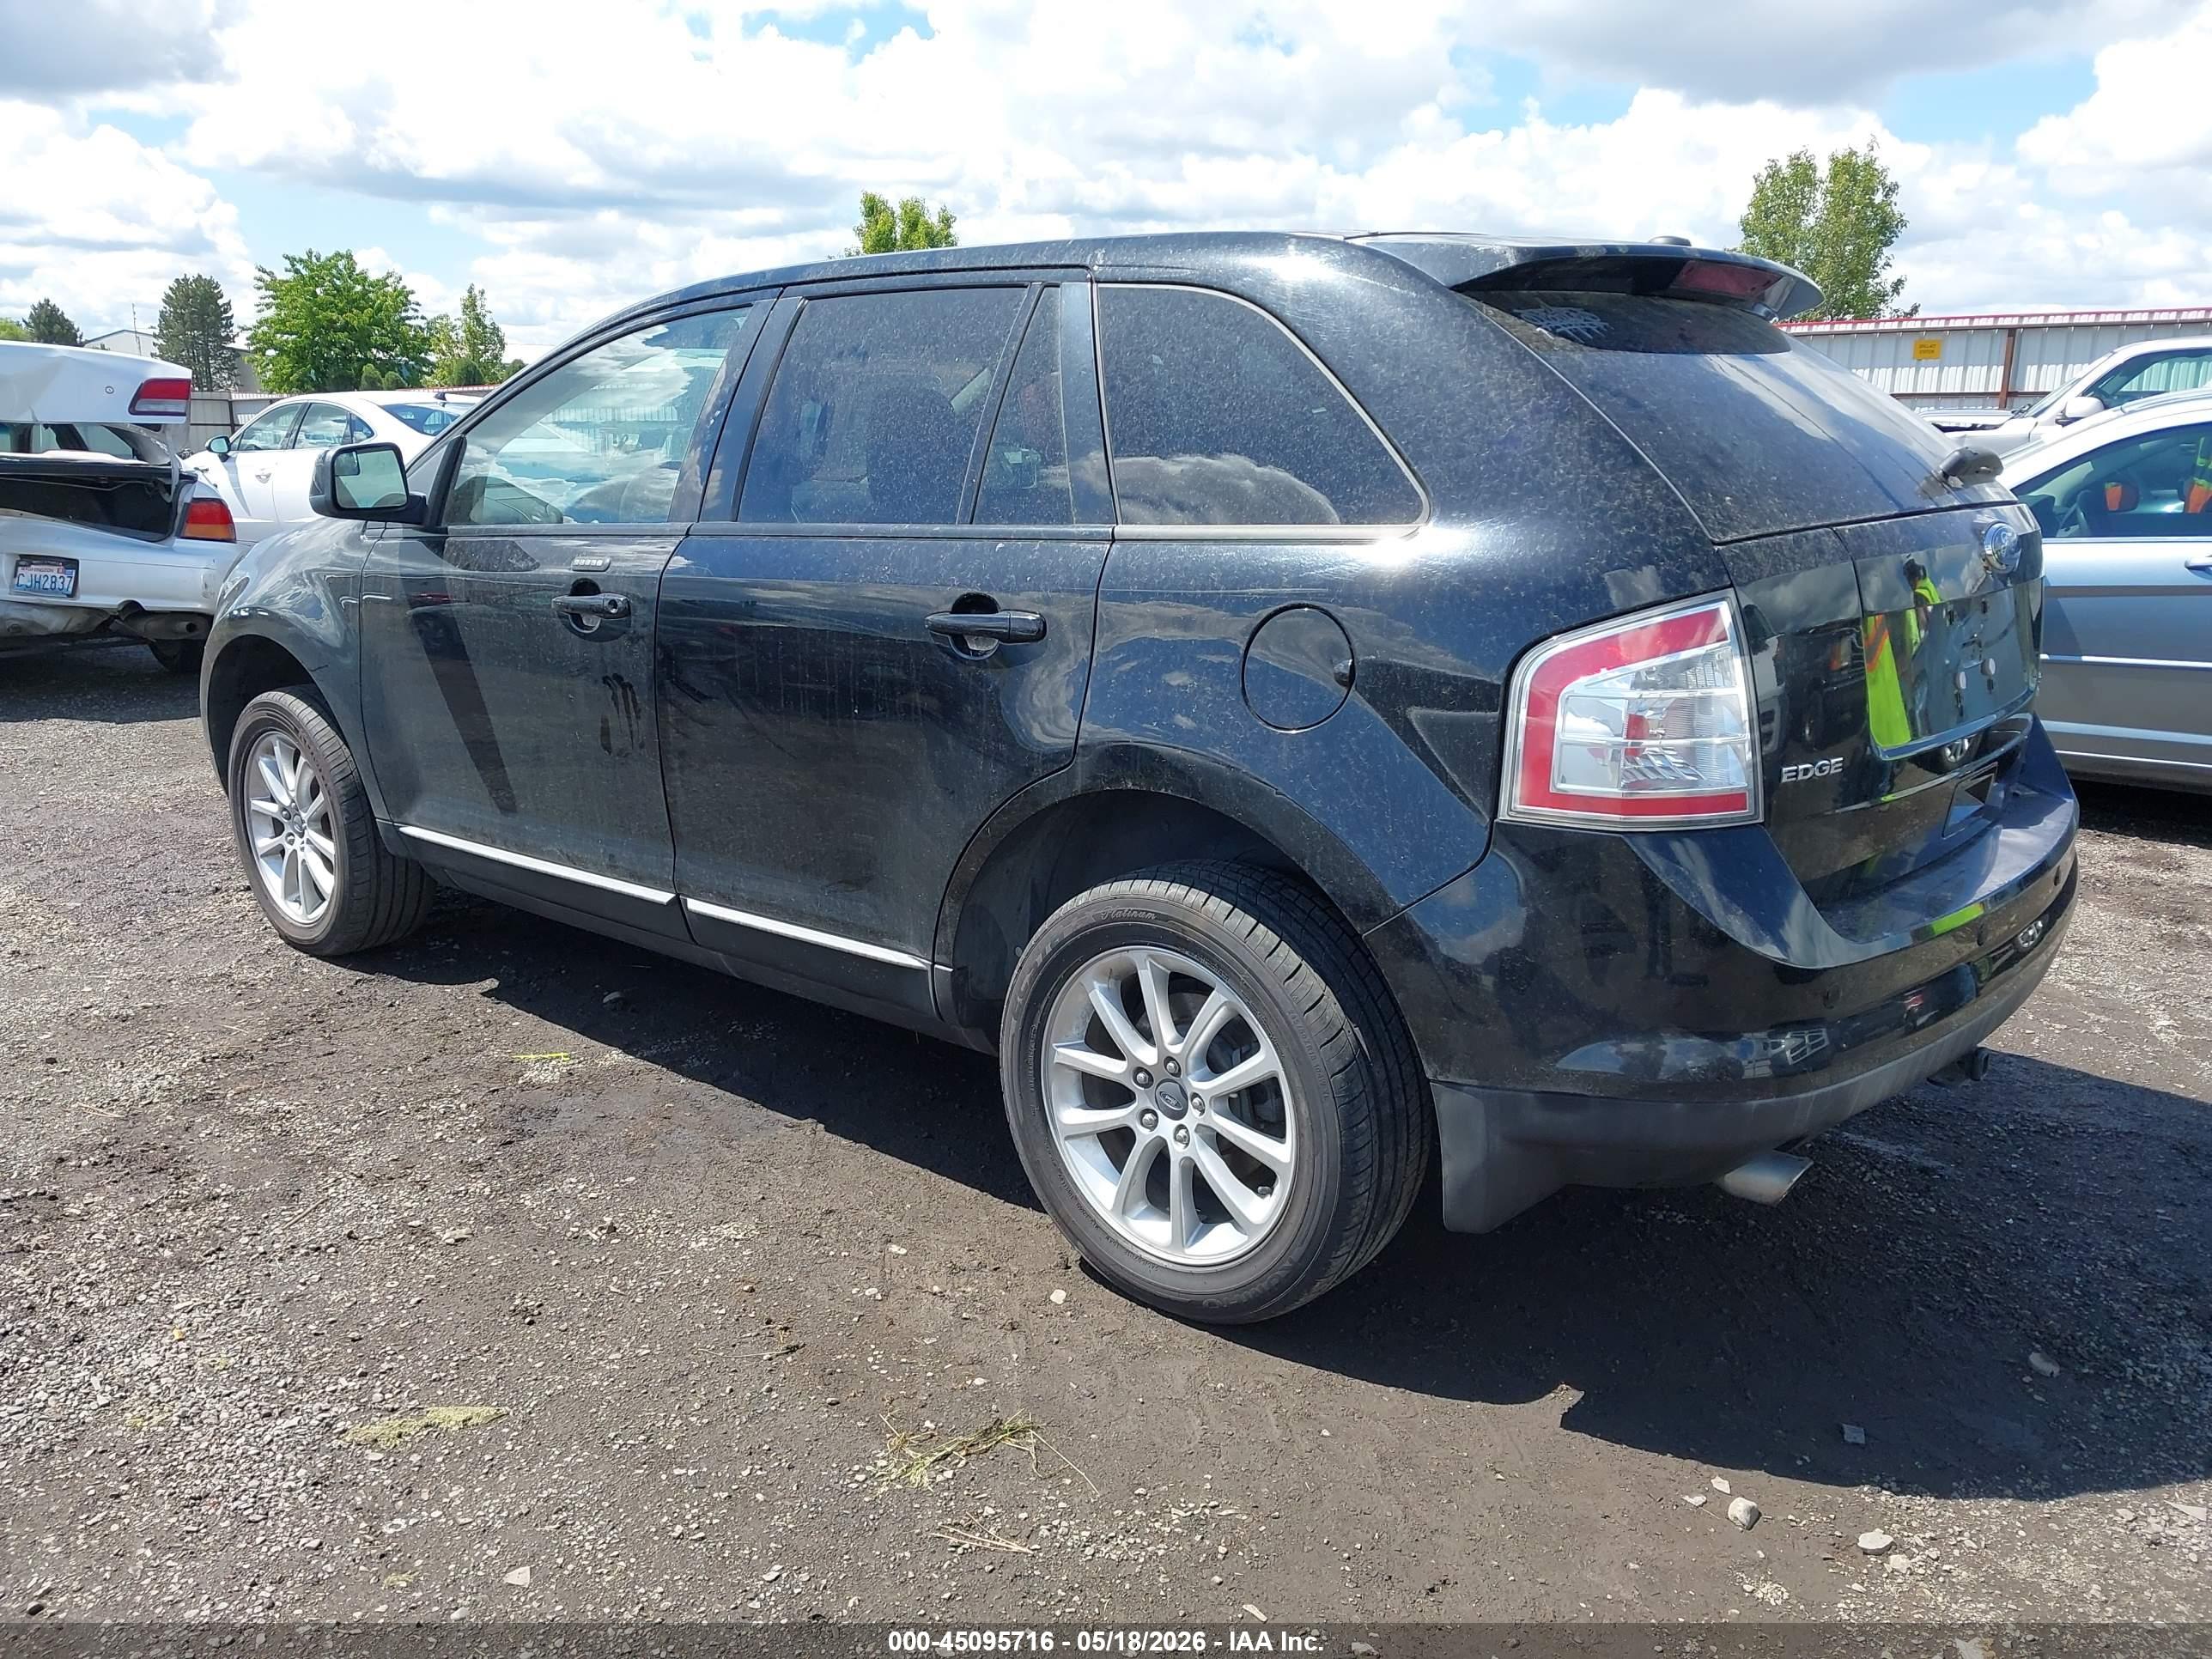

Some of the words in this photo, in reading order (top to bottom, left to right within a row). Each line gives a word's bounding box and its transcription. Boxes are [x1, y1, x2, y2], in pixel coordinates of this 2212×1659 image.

[16, 574, 73, 591] CJH2837
[1781, 757, 1844, 783] EDGE
[1101, 905, 1157, 921] Platinum
